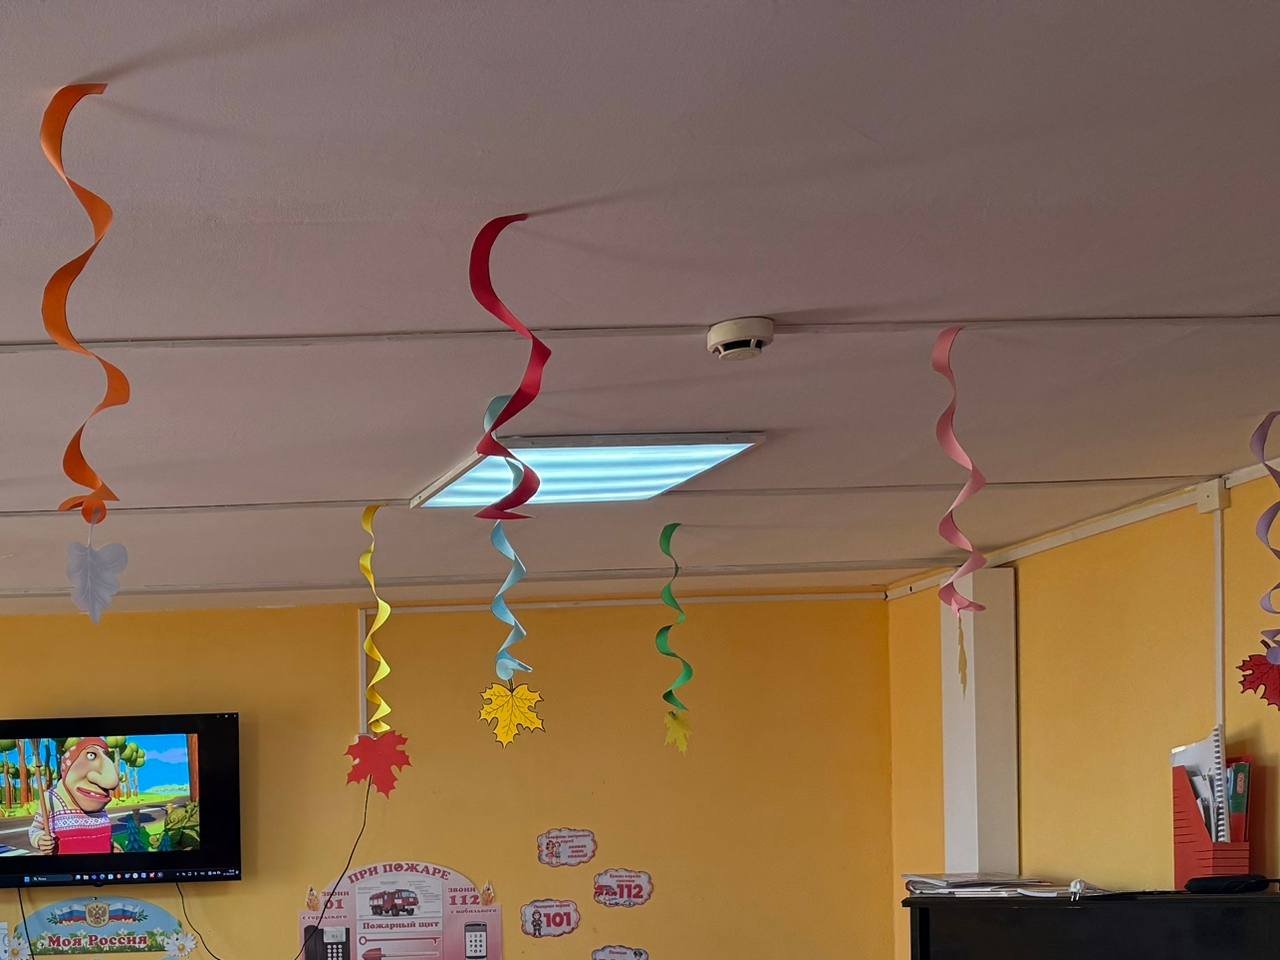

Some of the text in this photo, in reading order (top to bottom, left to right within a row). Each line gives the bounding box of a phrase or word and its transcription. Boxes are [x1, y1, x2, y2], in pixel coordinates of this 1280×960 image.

[347, 862, 451, 884] ПРИ ПОЖАРЕ
[616, 883, 643, 899] 112
[449, 894, 480, 906] 112
[362, 920, 440, 930] Пожарный щит
[543, 911, 571, 927] 101
[47, 934, 148, 947] Моя Россия
